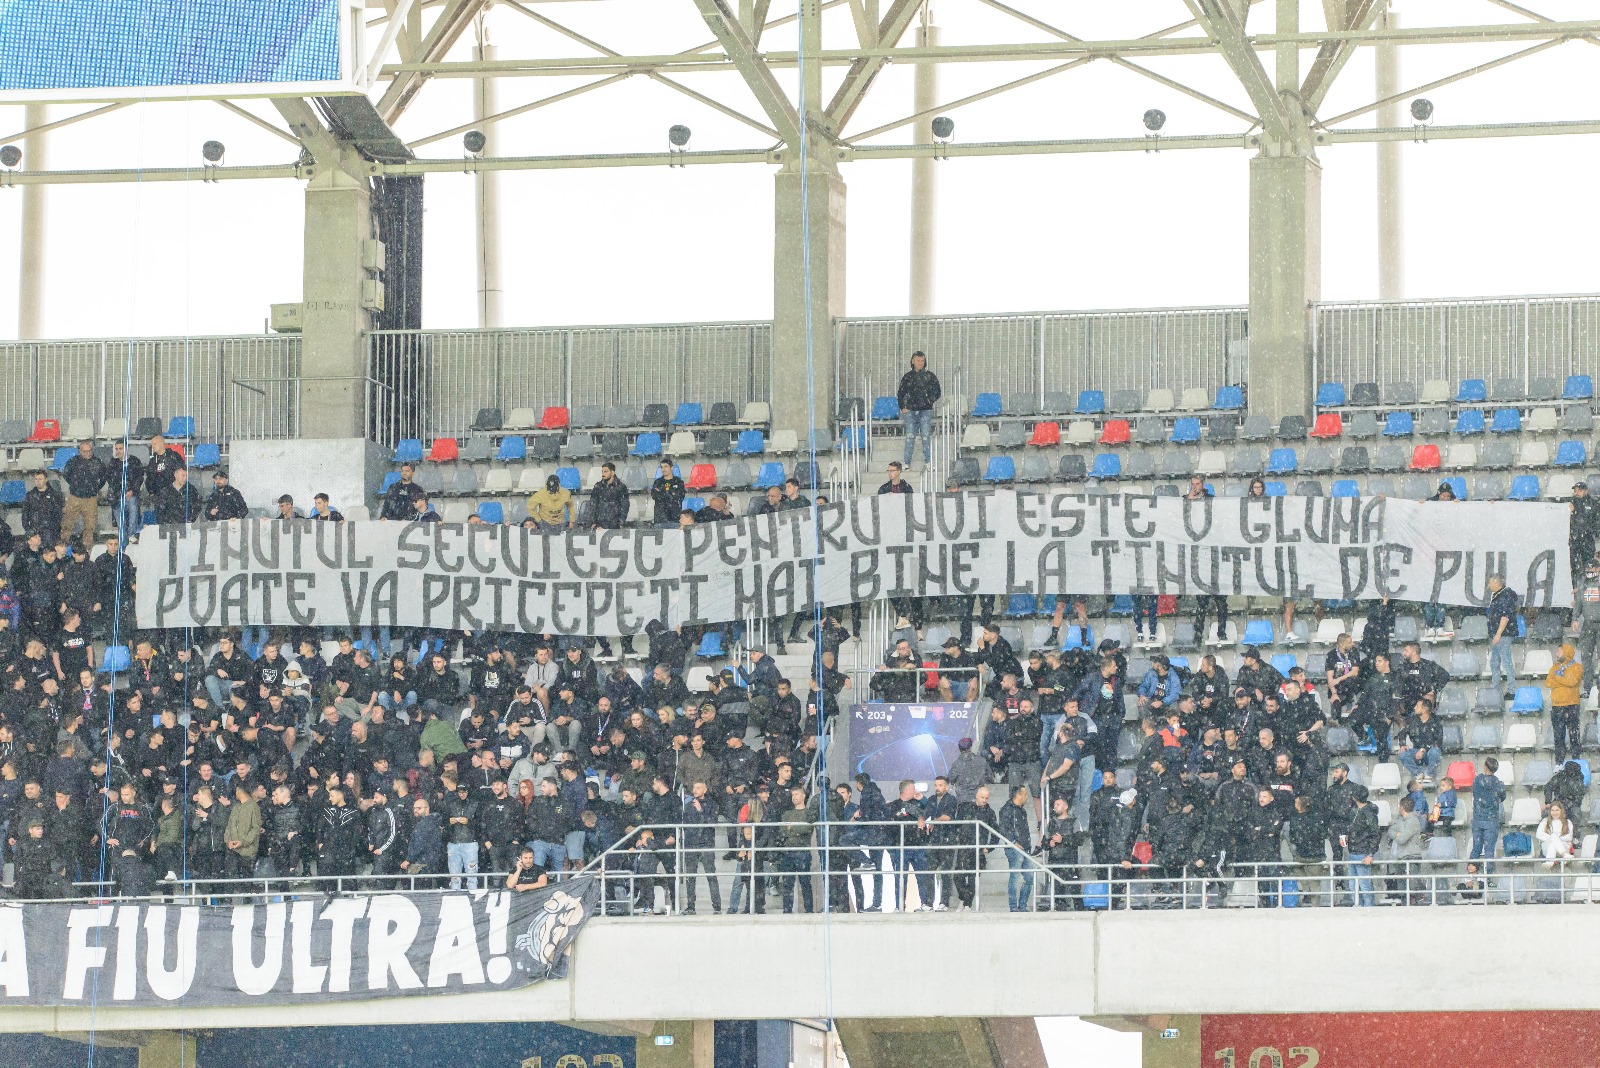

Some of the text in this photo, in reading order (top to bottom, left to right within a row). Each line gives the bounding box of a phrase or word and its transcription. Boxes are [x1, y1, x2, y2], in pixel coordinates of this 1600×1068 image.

[158, 519, 373, 575] TINUTUL
[397, 520, 664, 579] SECUIESC
[684, 495, 881, 573] PENTRU
[905, 490, 996, 542] NOI
[1016, 492, 1158, 538] ESTE
[1239, 495, 1388, 544] GLUMA
[156, 572, 317, 627] POATE
[340, 570, 399, 626] VA
[422, 574, 709, 635] PRICEPETI
[734, 557, 826, 622] MAI
[850, 541, 980, 602] BINE
[1006, 540, 1066, 600] LA
[1091, 540, 1314, 598] TINUTUL
[1339, 542, 1414, 600] DE
[867, 711, 886, 720] 203
[949, 710, 968, 719] 202
[63, 905, 199, 1001] FIU
